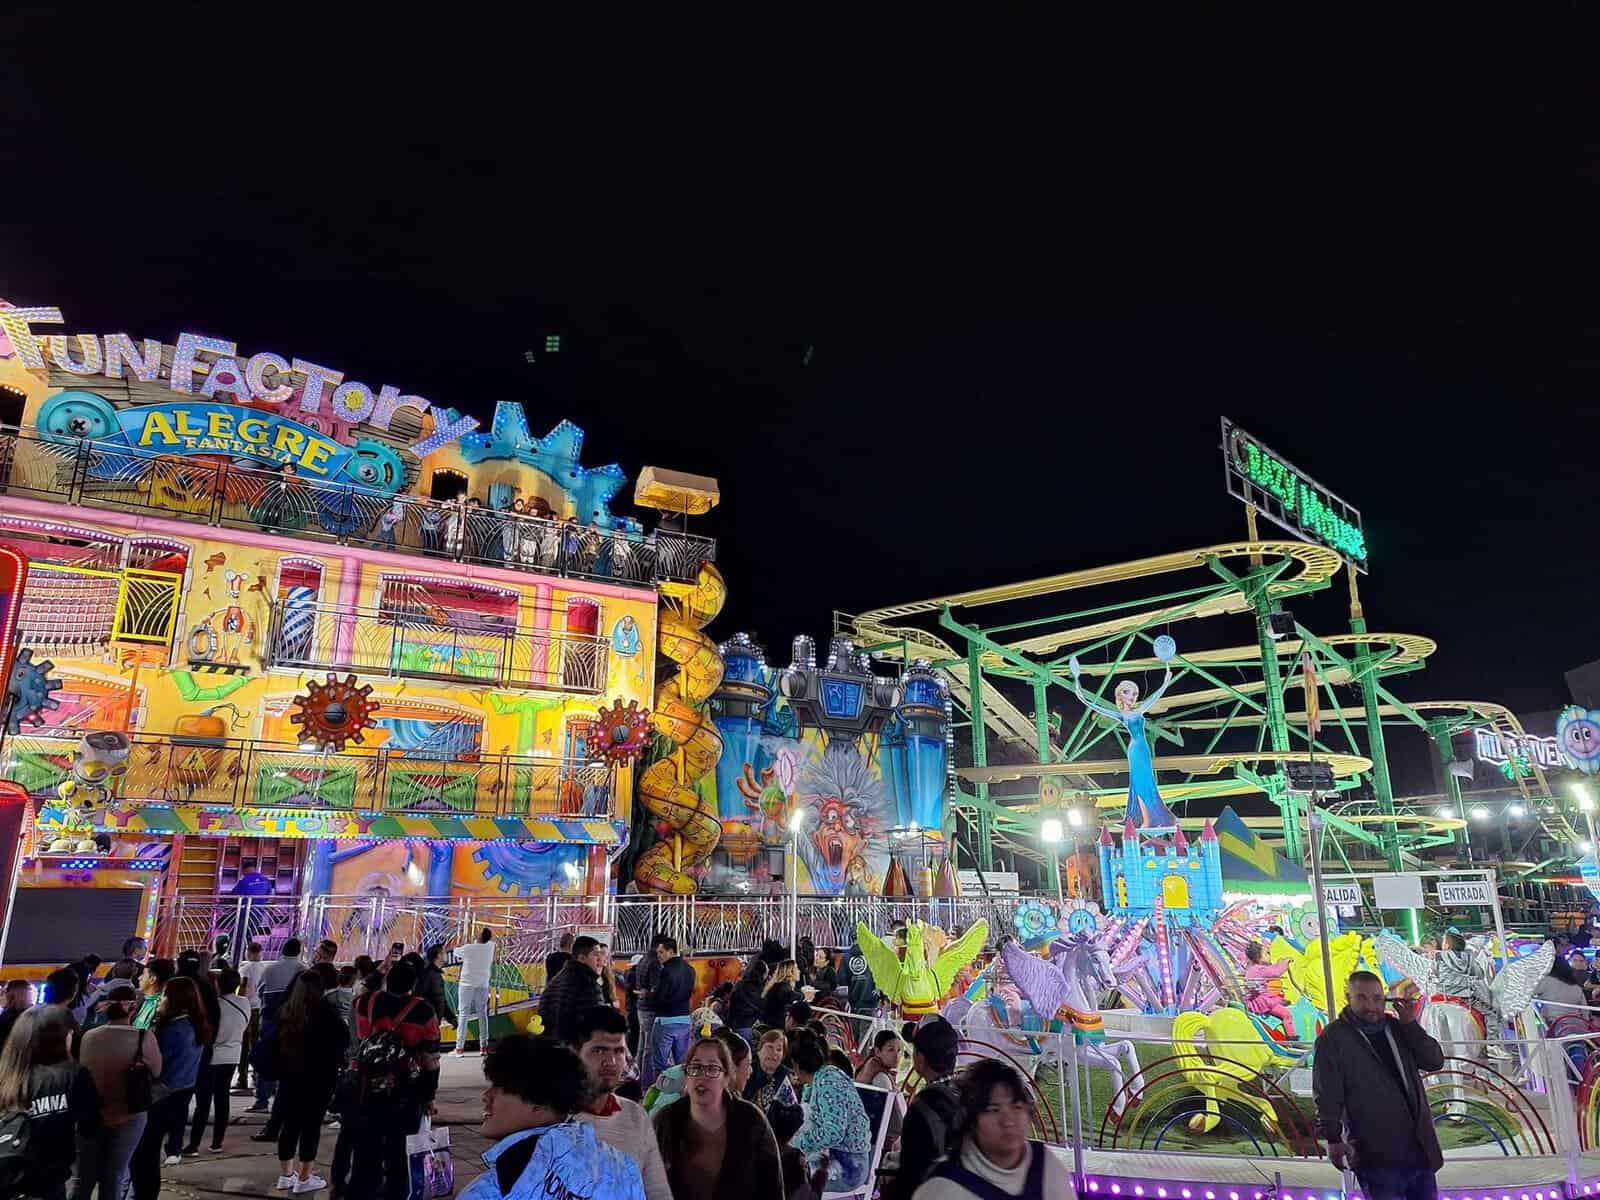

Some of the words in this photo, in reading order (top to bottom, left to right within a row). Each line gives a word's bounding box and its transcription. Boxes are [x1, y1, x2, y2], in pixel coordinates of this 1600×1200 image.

[0, 306, 162, 382] FUN
[138, 410, 337, 475] ALEGRE
[184, 436, 293, 464] FANTASIA
[197, 811, 376, 834] FACTORY
[1443, 887, 1485, 901] ENTRADA
